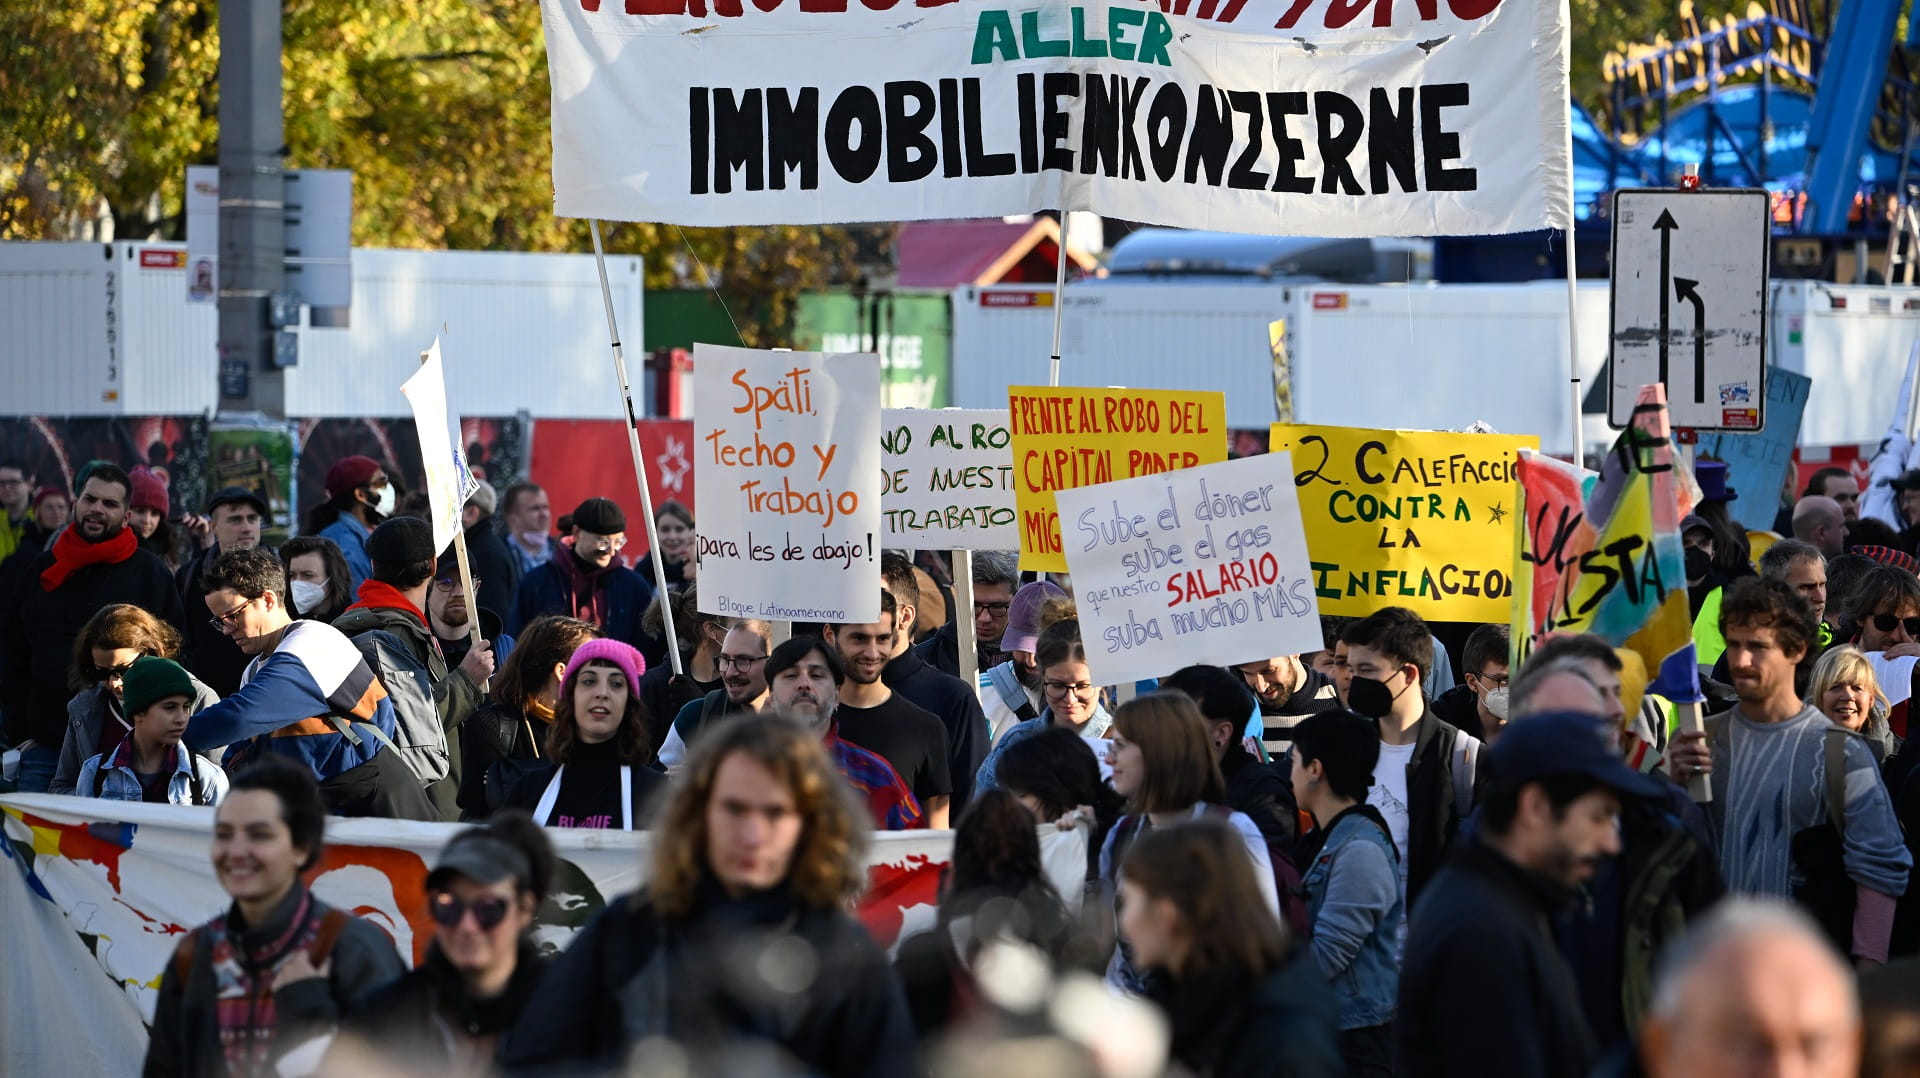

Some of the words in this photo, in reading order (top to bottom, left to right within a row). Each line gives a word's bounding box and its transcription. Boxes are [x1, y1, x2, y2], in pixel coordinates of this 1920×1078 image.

[971, 9, 1173, 67] ALLER
[690, 72, 1477, 196] IMMOBILIENKONZERNE
[929, 424, 963, 449] AL
[1009, 395, 1076, 436] FRENTE
[1079, 396, 1102, 434] AL
[1104, 396, 1160, 434] ROBO
[1170, 400, 1209, 434] DEL
[705, 428, 795, 468] Techo
[812, 444, 837, 481] y
[929, 465, 1015, 492] NUEST
[740, 476, 859, 528] Trabajo
[883, 505, 1016, 533] TRABAJO
[1078, 500, 1149, 553] Sube
[1157, 486, 1181, 531] el
[1195, 477, 1274, 521] döner
[1329, 489, 1472, 524] CONTRA
[749, 531, 775, 561] les
[782, 531, 804, 561] de
[1121, 538, 1184, 578] sube
[1194, 524, 1217, 559] el
[1225, 525, 1272, 562] gas
[1378, 526, 1422, 549] LA
[1167, 551, 1280, 608] SALARIO
[759, 602, 845, 620] Latinoamericano
[1103, 609, 1164, 654] suba
[1171, 597, 1250, 635] mucho
